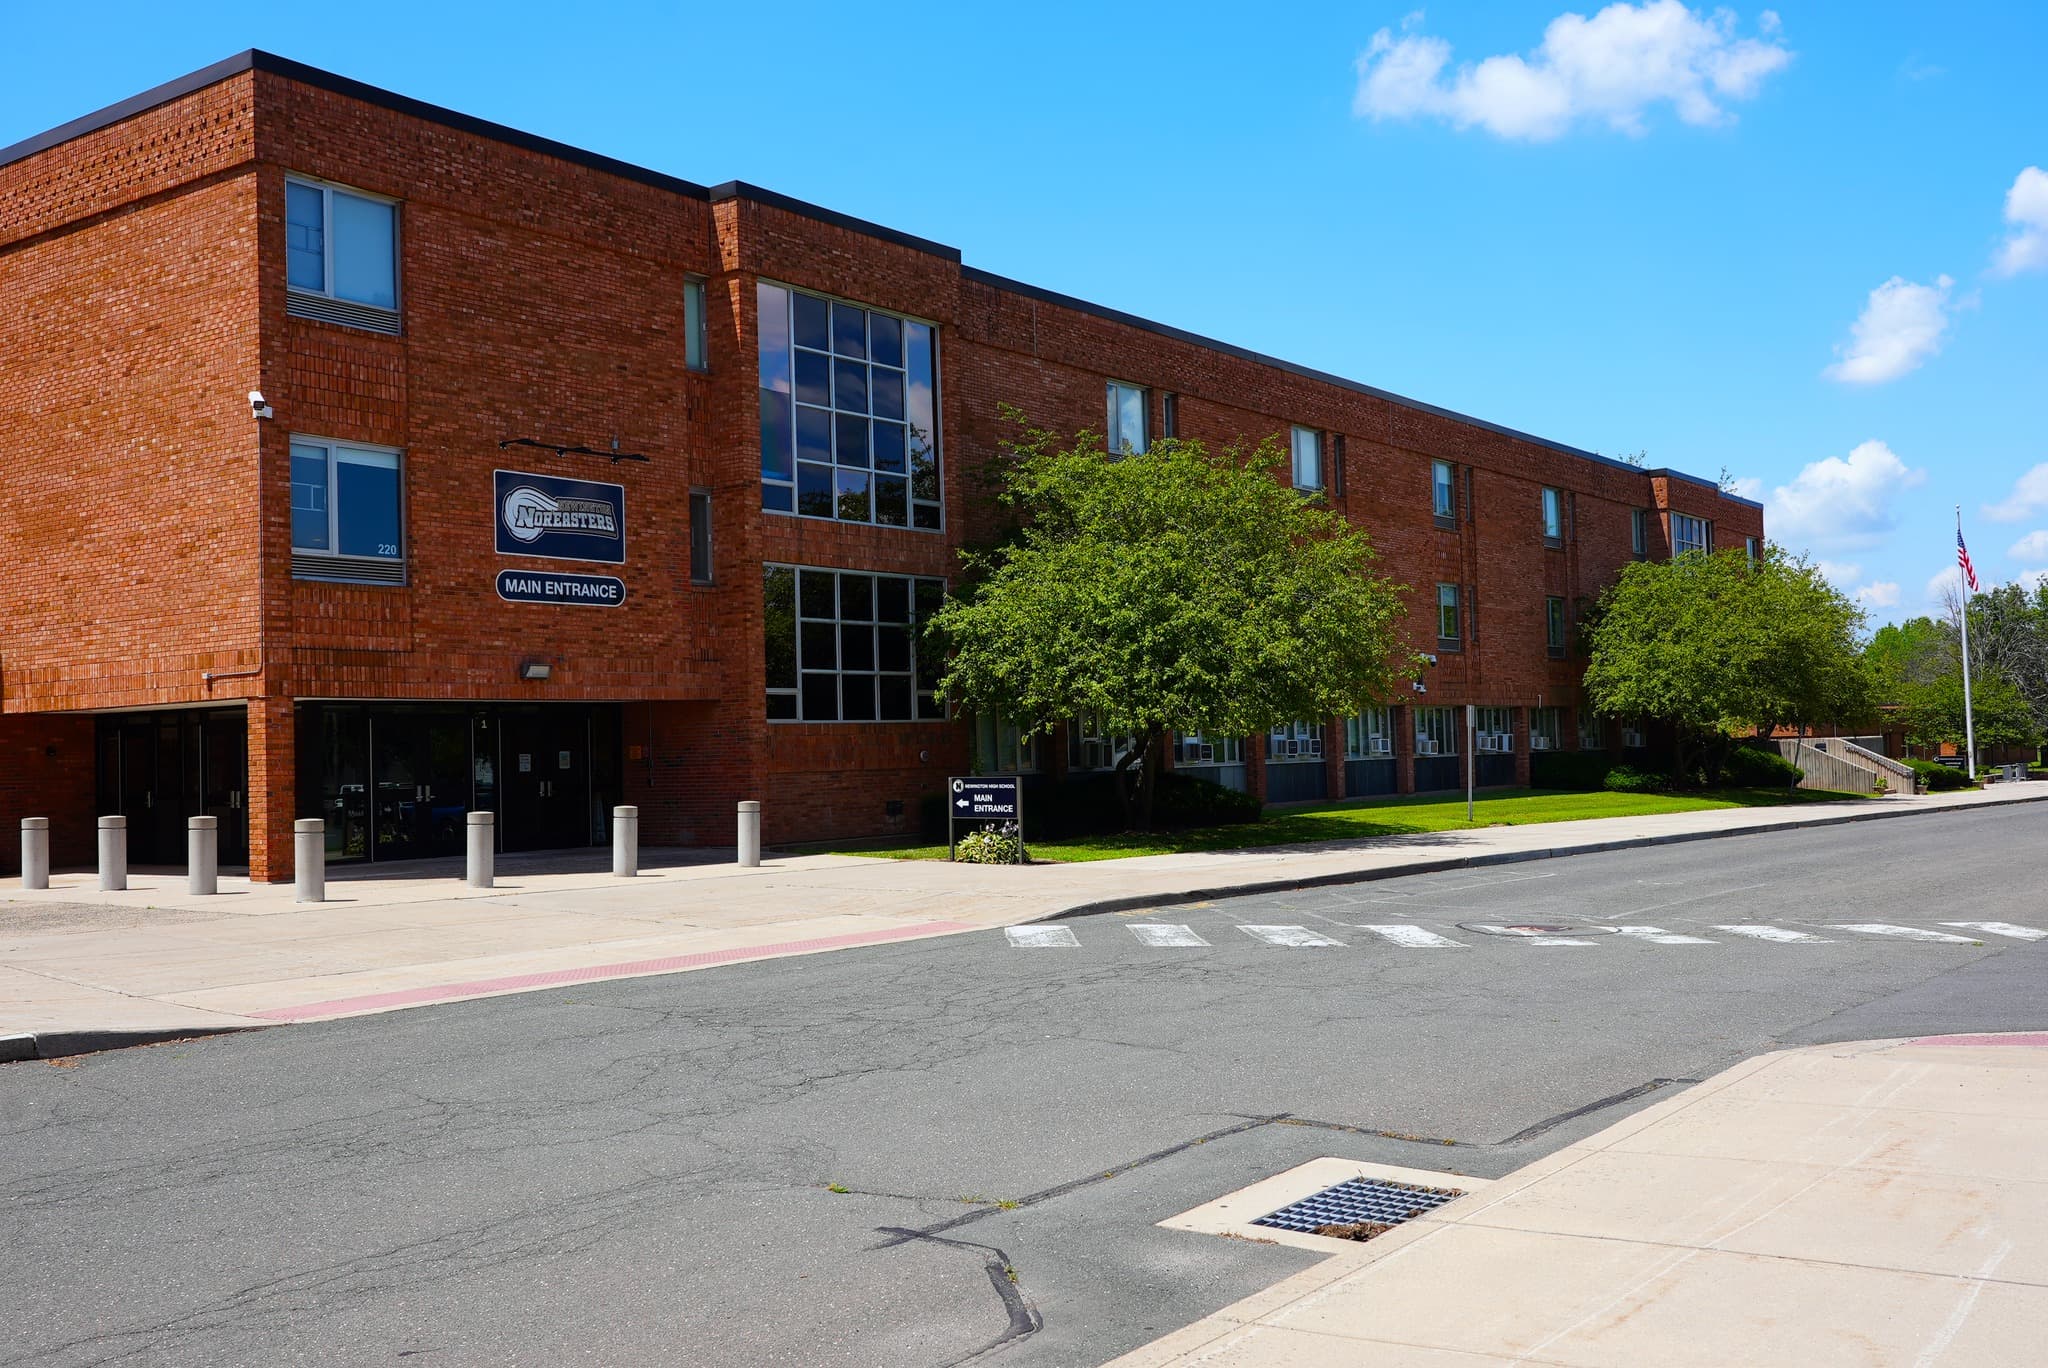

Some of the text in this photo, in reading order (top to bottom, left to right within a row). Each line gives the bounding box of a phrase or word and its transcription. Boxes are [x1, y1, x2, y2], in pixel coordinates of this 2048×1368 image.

[515, 505, 615, 531] NOREASTERS
[378, 543, 397, 555] 220
[505, 578, 617, 598] MAIN ENTRANCE
[481, 720, 487, 728] 1
